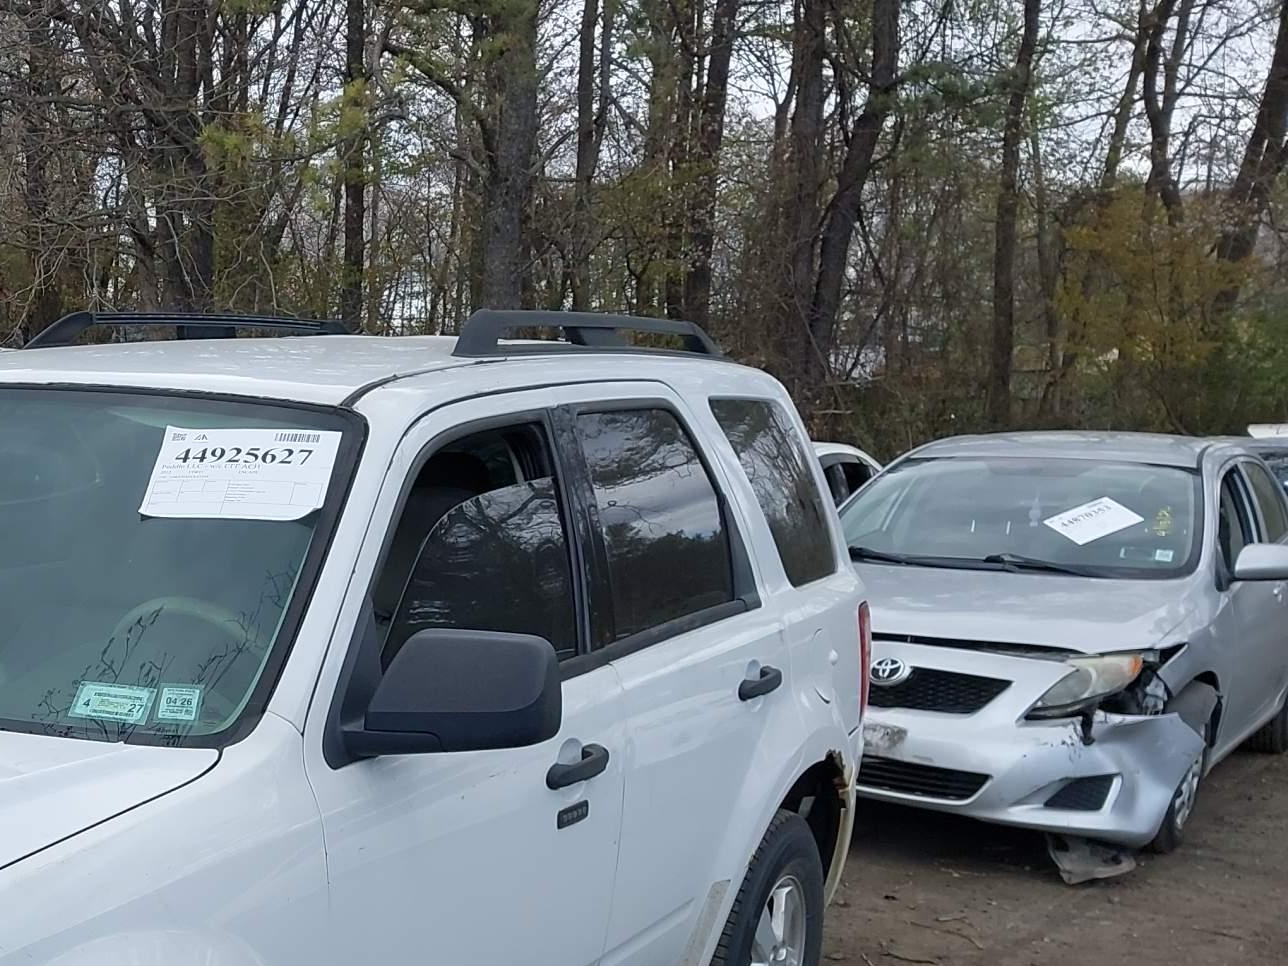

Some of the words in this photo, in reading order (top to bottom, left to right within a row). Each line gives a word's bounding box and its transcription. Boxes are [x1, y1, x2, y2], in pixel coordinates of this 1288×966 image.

[175, 447, 314, 465] 44925627
[83, 698, 91, 707] 4
[165, 696, 177, 705] 04
[181, 697, 193, 706] 26
[127, 703, 144, 714] 27
